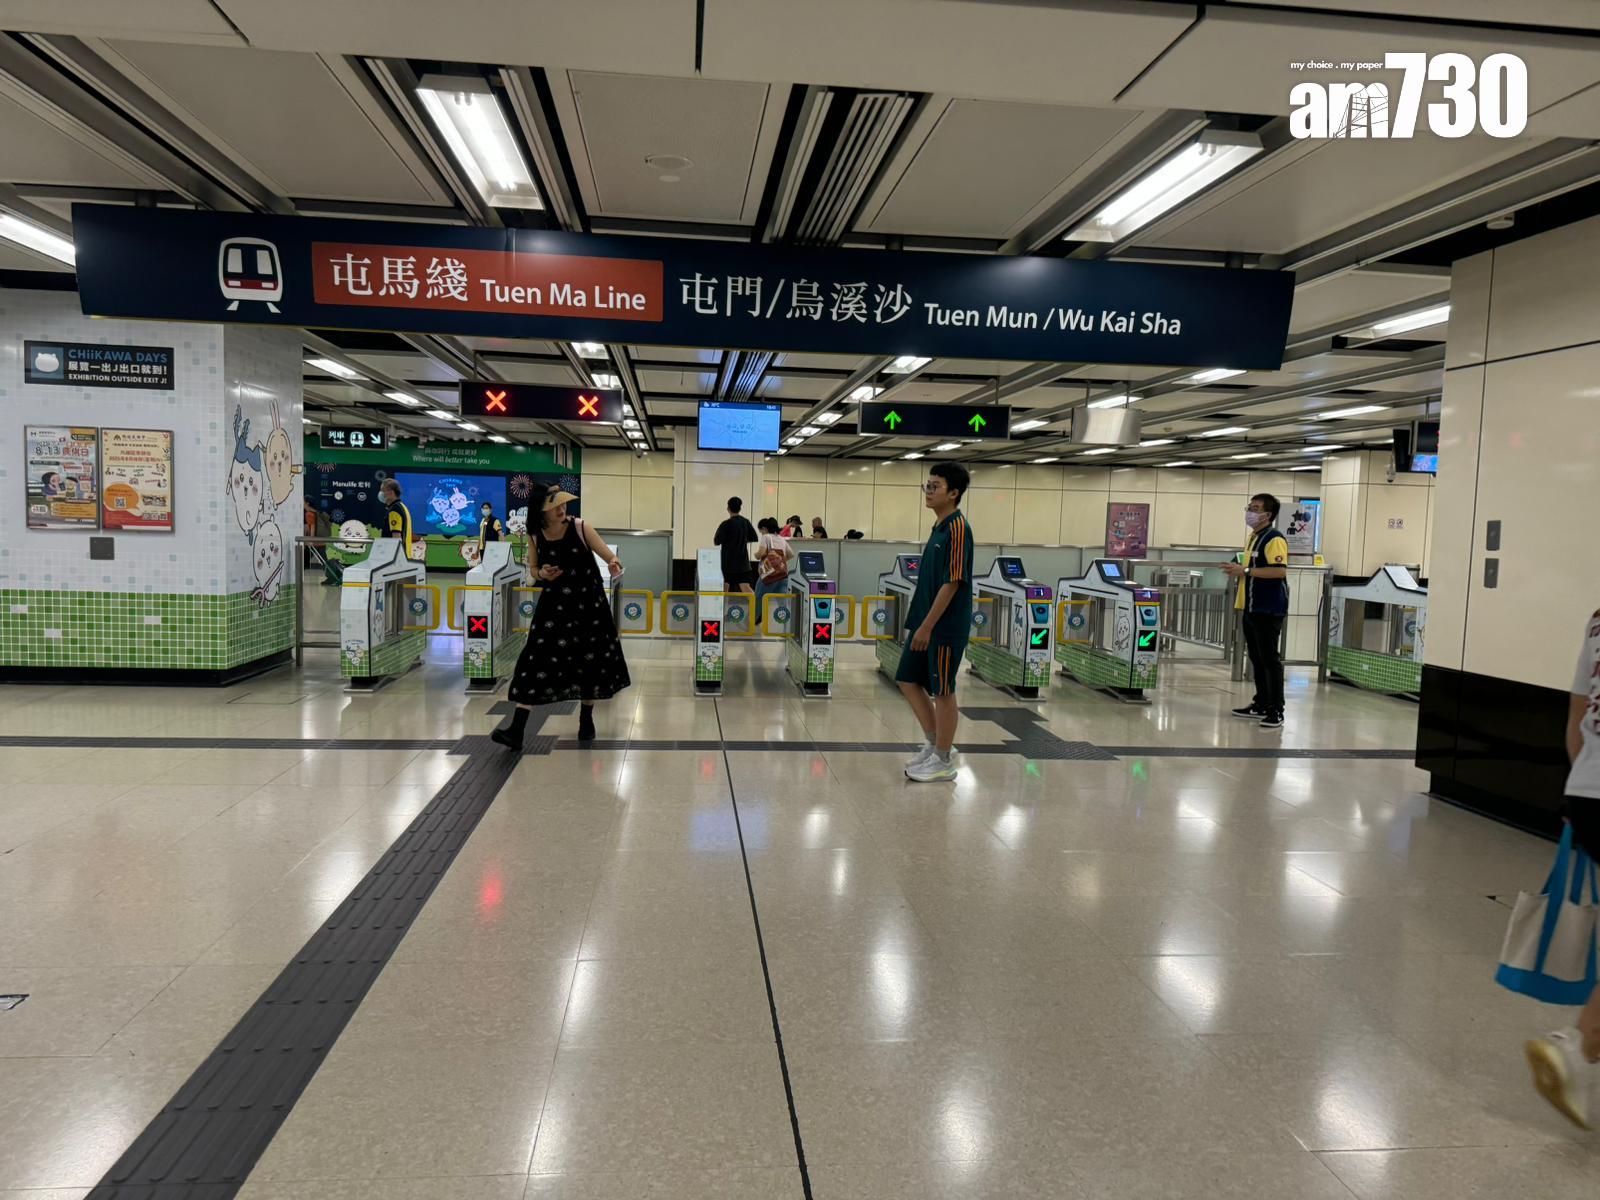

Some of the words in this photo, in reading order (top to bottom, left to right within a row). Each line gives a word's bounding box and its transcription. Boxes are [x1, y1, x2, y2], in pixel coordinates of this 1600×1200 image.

[329, 252, 468, 302] 屯馬綫
[479, 278, 542, 305] Tuen
[549, 282, 587, 308] Ma
[594, 285, 646, 310] Line
[679, 272, 913, 324] 屯門/烏溪沙
[924, 302, 979, 327] Tuen
[986, 305, 1038, 329] Mun
[1058, 308, 1094, 332] Wu
[1100, 310, 1135, 333] Kai
[1140, 312, 1182, 335] Sha
[136, 352, 168, 363] DAYS
[68, 373, 110, 382] EXHIBITION
[412, 455, 433, 463] Where
[332, 480, 357, 488] Manulife
